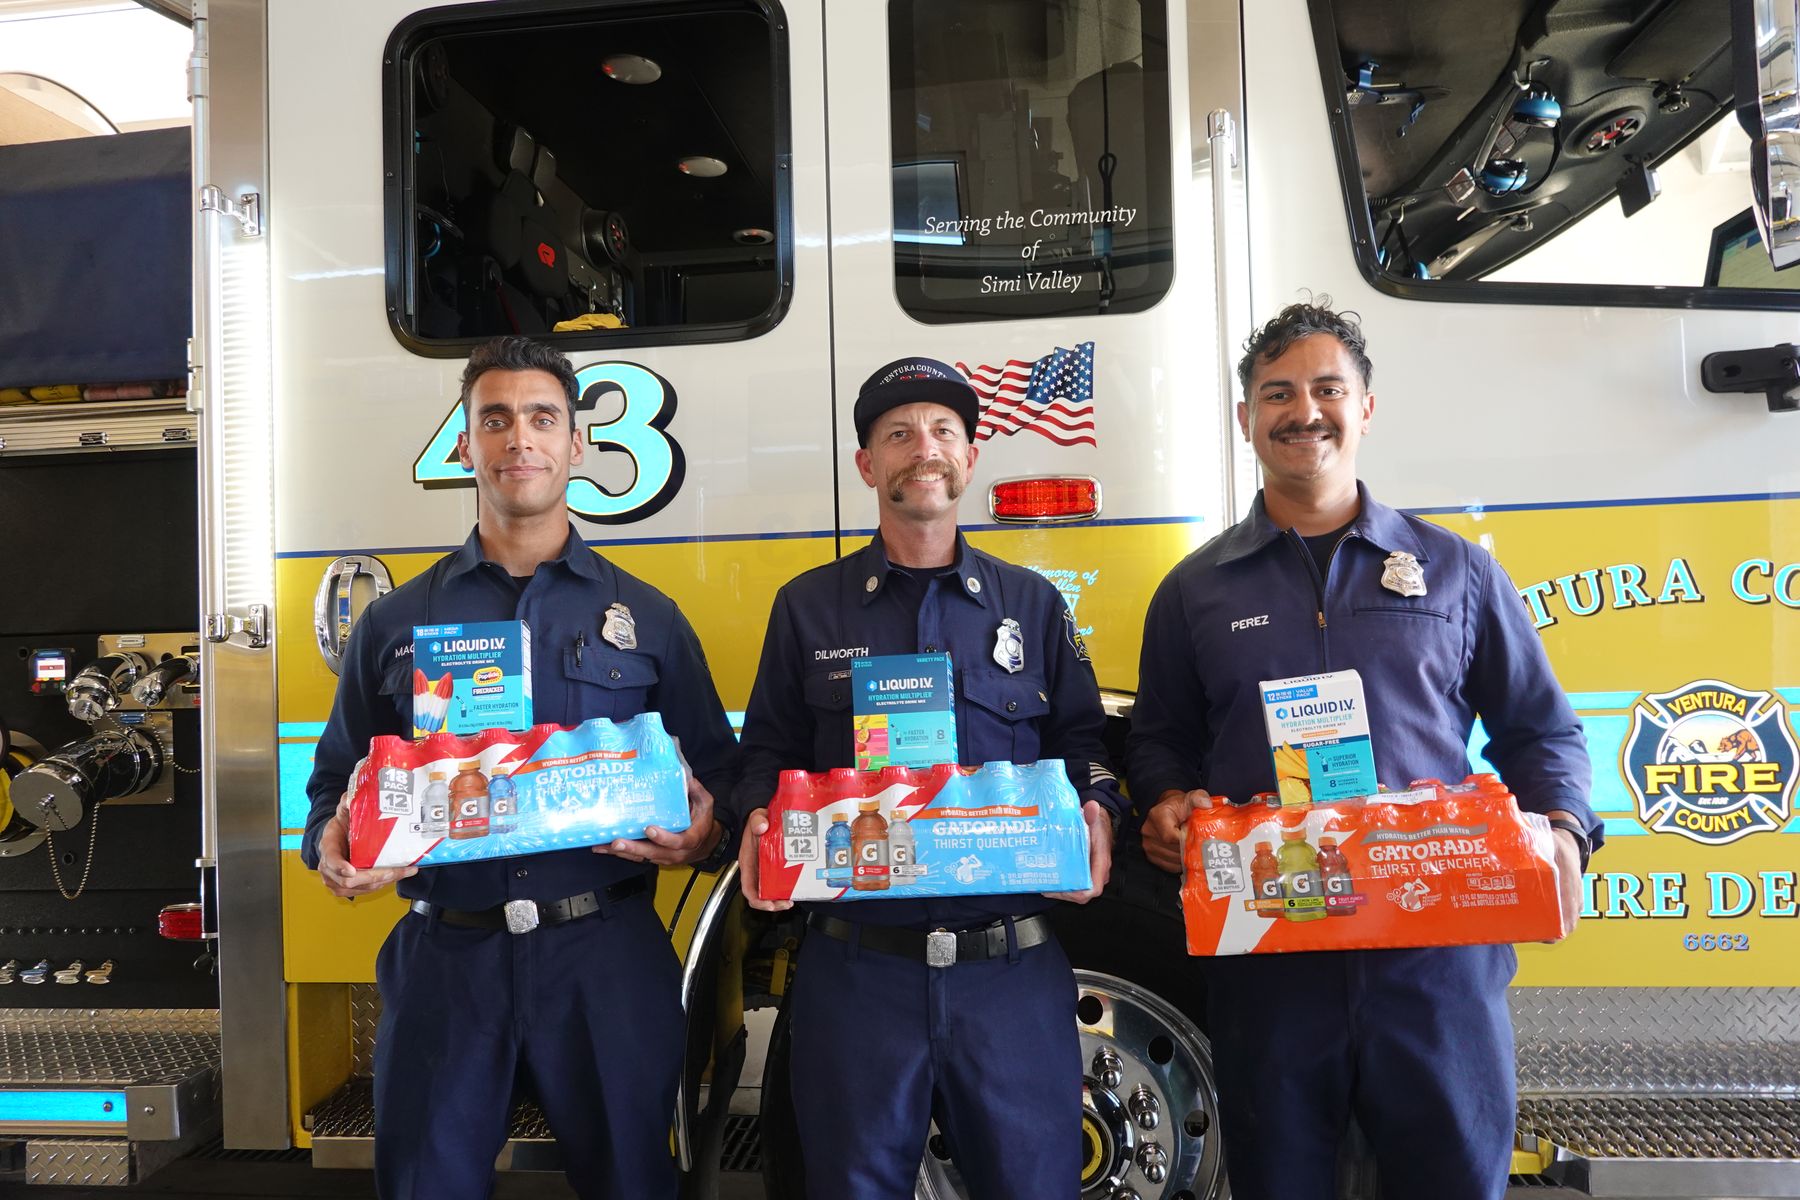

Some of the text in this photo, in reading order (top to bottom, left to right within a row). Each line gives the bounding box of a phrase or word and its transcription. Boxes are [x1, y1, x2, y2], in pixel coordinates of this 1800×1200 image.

[924, 206, 1136, 236] Serving the Community
[1021, 239, 1042, 261] of
[981, 270, 1082, 294] Simi Valley
[1231, 614, 1270, 632] PEREZ
[443, 637, 506, 653] LIQUID I.V.
[432, 651, 502, 663] HYDRATION MULTIPLIER
[814, 647, 869, 661] DILWORTH
[879, 677, 933, 691] LIQUID I.V.
[868, 691, 933, 701] HYDRATION MULTIPLIER
[1267, 692, 1276, 701] 12
[473, 702, 491, 711] FASTER
[492, 701, 519, 709] HYDRATION
[1291, 699, 1356, 718] LIQUID I.V.
[1667, 691, 1747, 716] VENTURA
[1280, 714, 1353, 728] HYDRATION MULTIPLIER
[936, 729, 945, 740] 8
[1303, 739, 1340, 748] SUGAR-FREE
[385, 769, 409, 785] 18
[535, 761, 635, 786] GATORADE
[1644, 762, 1783, 794] FIRE
[384, 782, 408, 792] PACK
[1329, 780, 1337, 788] 8
[385, 793, 408, 808] 12
[788, 813, 812, 827] 18
[1674, 806, 1752, 833] COUNTY
[788, 827, 813, 835] PACK
[932, 820, 1036, 836] GATORADE
[1376, 826, 1470, 840] HYDRATES BETTER THAN WATER
[790, 838, 812, 854] 12
[934, 836, 1038, 850] THIRST QUENCHER
[1207, 842, 1233, 858] 18
[1368, 837, 1488, 862] GATORADE
[1208, 858, 1236, 867] PACK
[1371, 856, 1491, 877] THIRST QUENCHER
[857, 867, 865, 875] 6
[893, 866, 900, 874] 6
[1212, 870, 1237, 886] 12
[1329, 897, 1337, 905] 6
[1580, 872, 1690, 918] IRE
[1248, 901, 1256, 909] 6
[1288, 899, 1296, 907] 6
[1683, 932, 1749, 951] 6662
